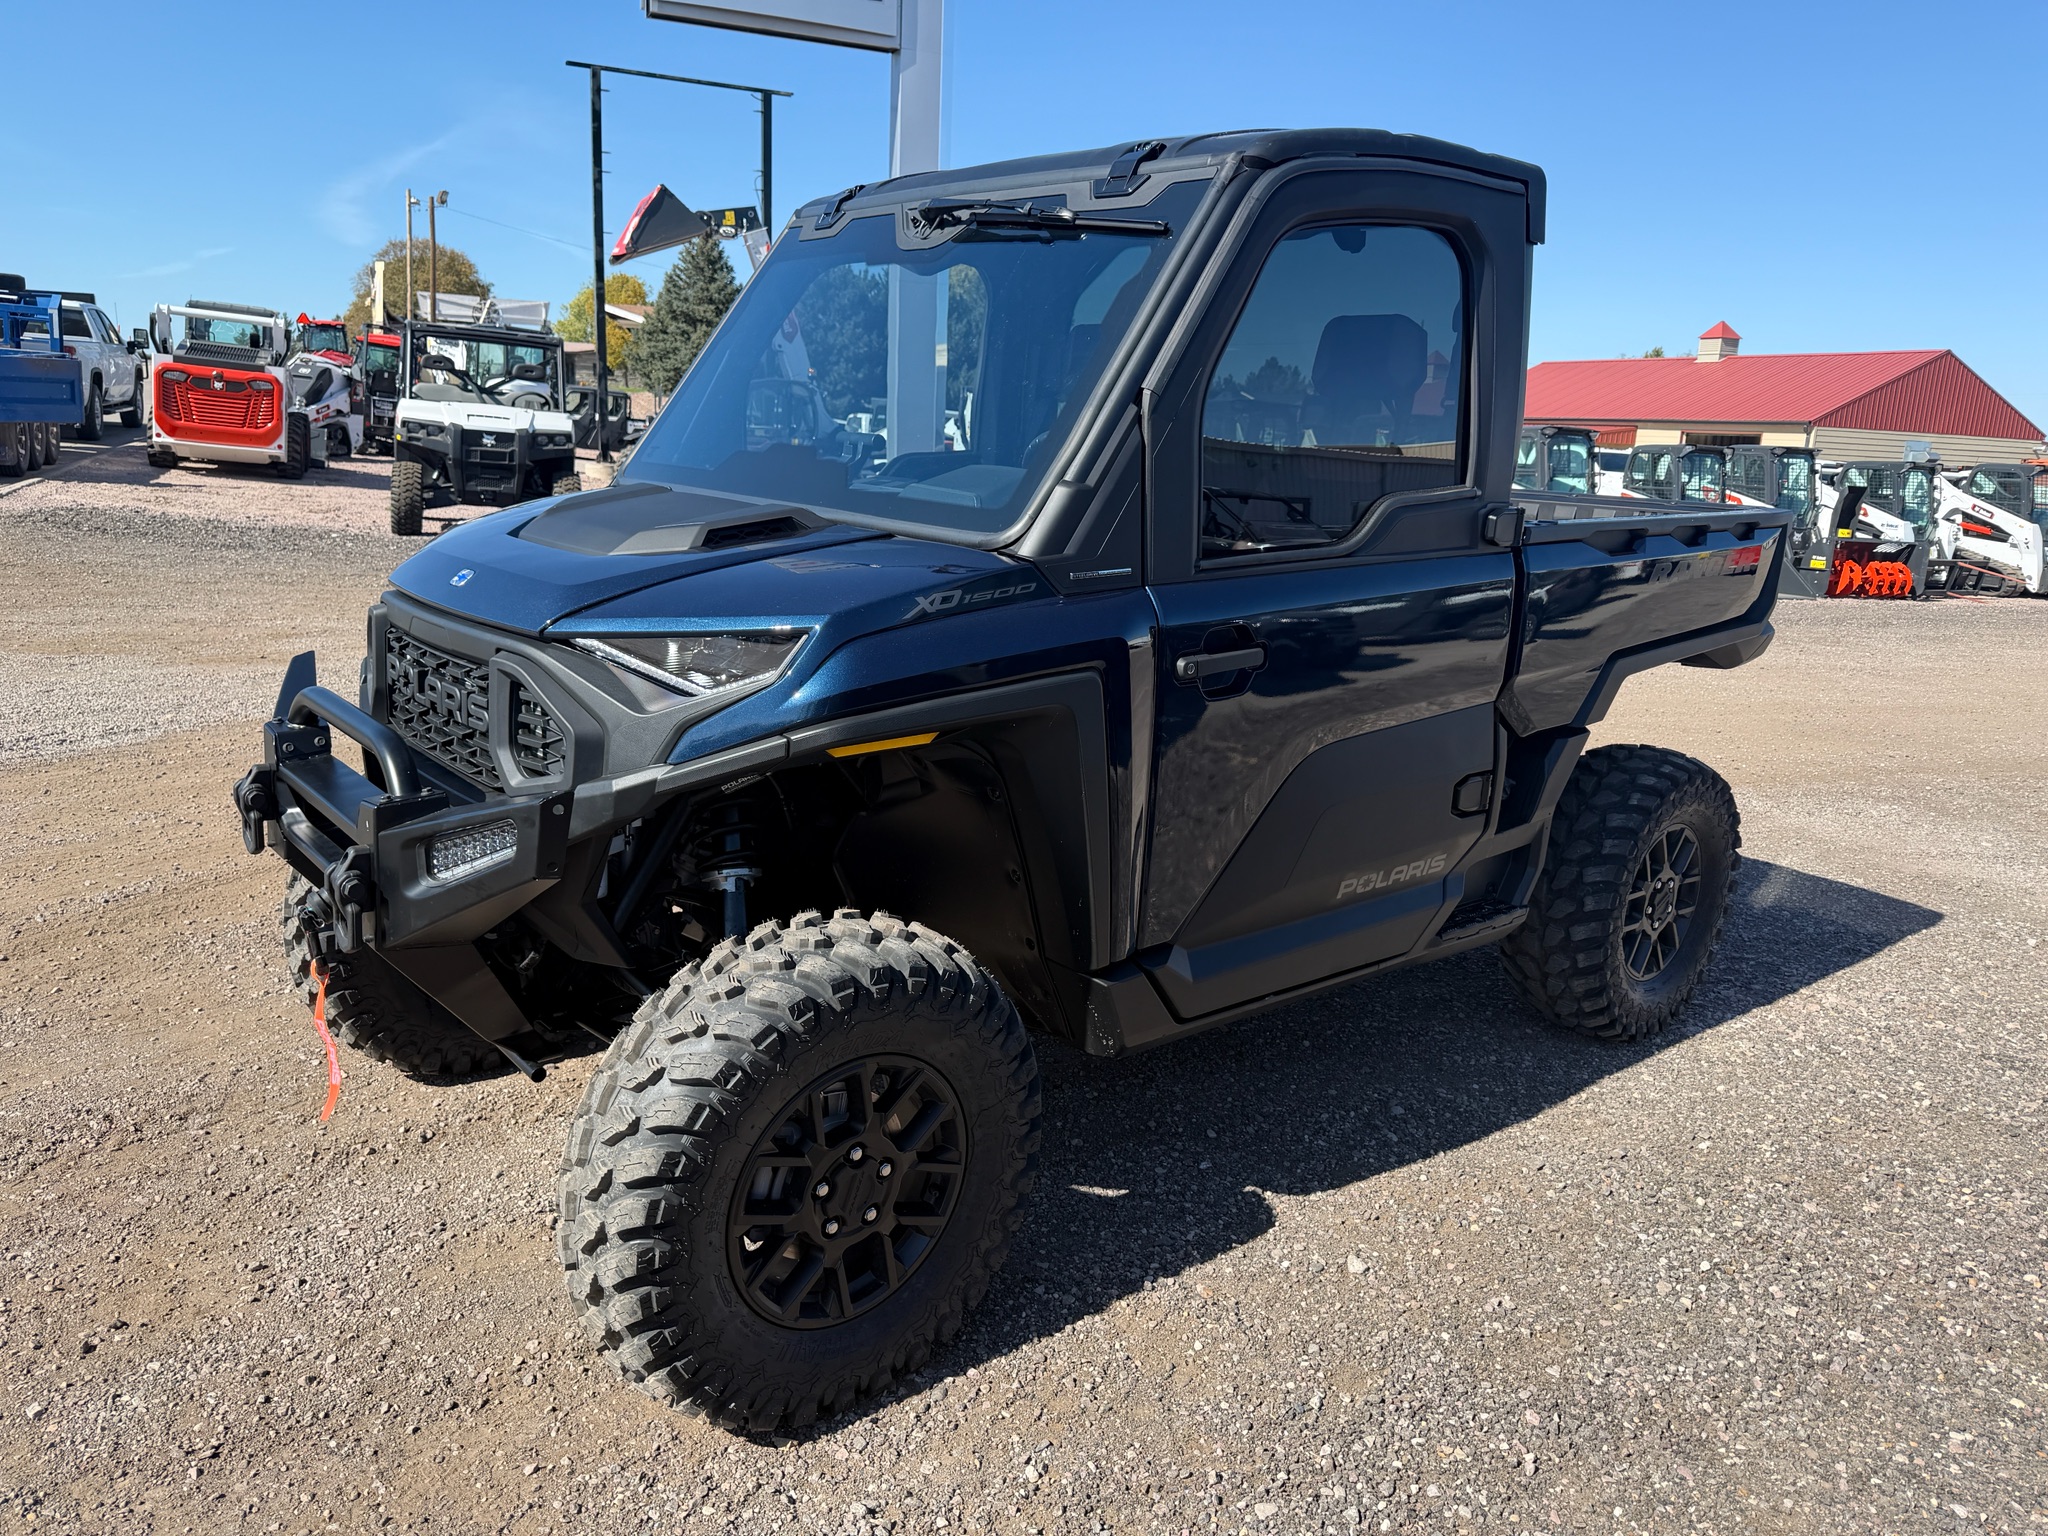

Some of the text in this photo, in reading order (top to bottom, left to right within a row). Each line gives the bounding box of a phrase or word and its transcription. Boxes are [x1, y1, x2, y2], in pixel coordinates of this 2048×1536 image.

[1648, 551, 1758, 584] RANGER
[901, 583, 1037, 620] XD 1500
[386, 653, 489, 733] POLARIS
[1336, 854, 1447, 899] POLARIS
